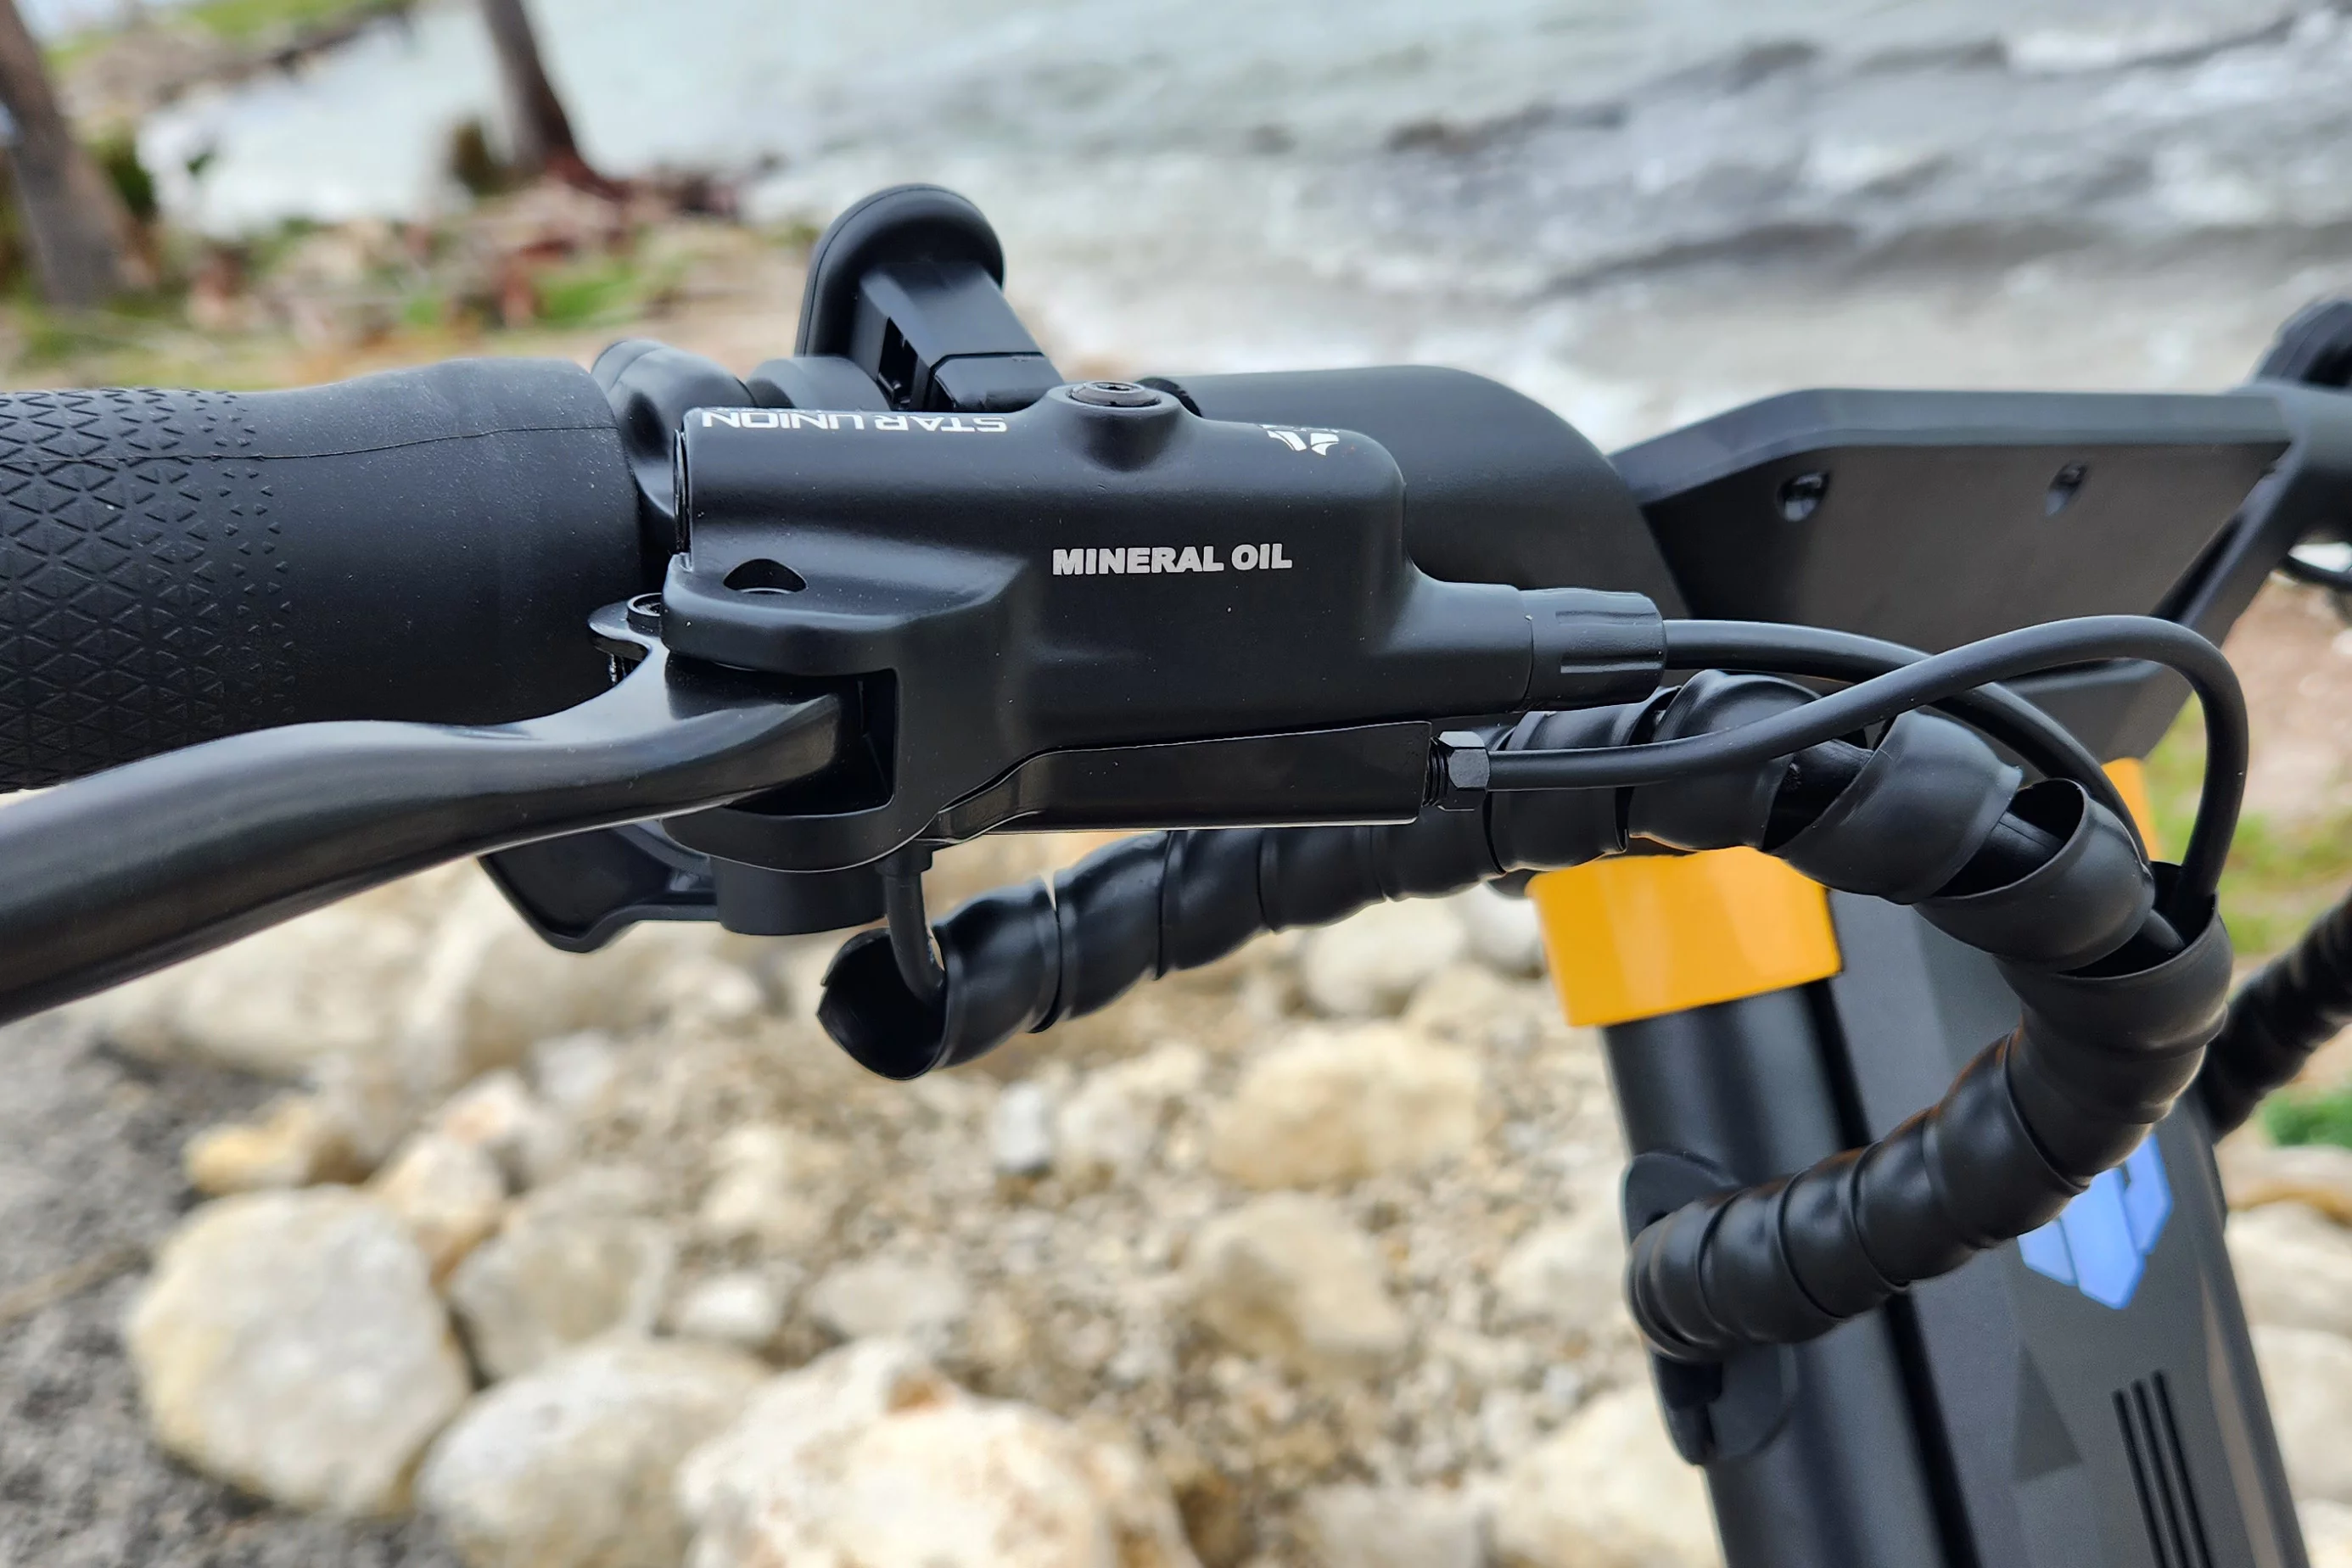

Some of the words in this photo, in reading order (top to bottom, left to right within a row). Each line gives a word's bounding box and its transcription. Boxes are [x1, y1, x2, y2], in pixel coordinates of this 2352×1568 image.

[702, 411, 865, 430] UNION
[874, 415, 1008, 433] STAR
[1052, 546, 1224, 575] MINERAL
[1231, 543, 1293, 571] OIL
